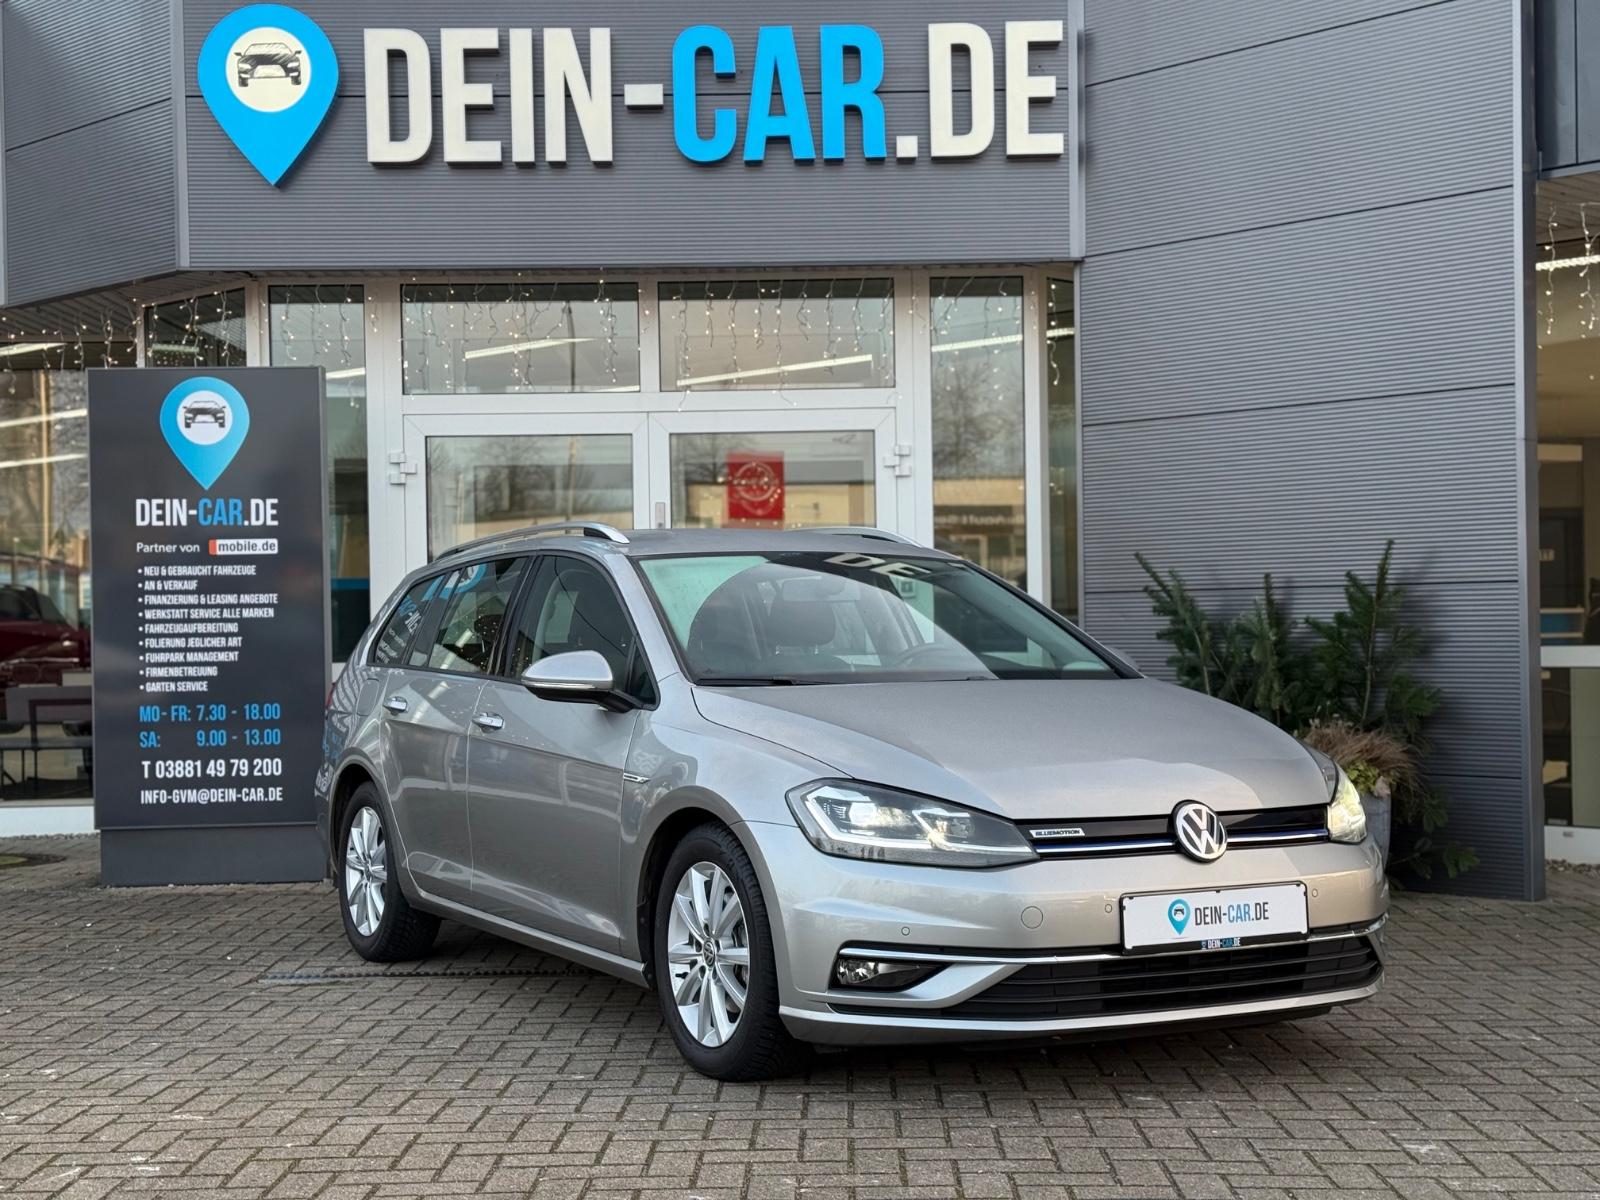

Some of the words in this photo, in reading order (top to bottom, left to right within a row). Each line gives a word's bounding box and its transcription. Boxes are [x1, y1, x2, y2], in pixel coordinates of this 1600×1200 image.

[363, 20, 1065, 165] DEIN-CAR.DE
[135, 498, 279, 526] DEIN-CAR.DE
[136, 542, 177, 553] Partner
[180, 544, 200, 552] von
[218, 541, 276, 552] mobile.de
[144, 566, 159, 576] NEU
[161, 566, 167, 576] &
[168, 565, 212, 576] GEBRAUCHT
[213, 565, 256, 575] FAHRZEUGE
[144, 581, 155, 590] AN
[157, 580, 162, 590] &
[163, 580, 198, 590] VERKAUF
[144, 595, 199, 605] FINANZIERUNG
[200, 595, 206, 604] &
[207, 594, 238, 604] LEASING
[239, 594, 278, 604] ANGEBOTE
[144, 609, 189, 619] WERKSTATT
[190, 609, 221, 618] SERVICE
[222, 608, 240, 618] ALLE
[242, 608, 274, 617] MARKEN
[145, 623, 238, 633] FAHRZEUGAUFBEREITUNG
[145, 638, 186, 648] FOLIERUNG
[187, 637, 226, 647] JEGLICHER
[227, 637, 242, 647] ART
[145, 652, 185, 662] FUHRPARK
[186, 651, 239, 661] MANAGEMENT
[145, 666, 218, 677] FIRMENBETREUUNG
[145, 682, 175, 692] GARTEN
[176, 681, 208, 691] SERVICE
[170, 705, 191, 721] FR:
[196, 704, 226, 721] 7.30
[244, 703, 281, 720] 18.00
[139, 731, 161, 748] SA:
[196, 729, 227, 747] 9.00
[244, 728, 281, 746] 13.00
[141, 760, 151, 779] T
[155, 760, 201, 779] 03881
[206, 759, 226, 777] 49
[230, 759, 249, 777] 79
[253, 758, 282, 776] 200
[140, 787, 283, 804] INFO-GVM@DEIN-CAR.DE
[1194, 901, 1270, 926] DEIN-CAR.DE
[1207, 937, 1241, 949] DEIN-CAR.DE
